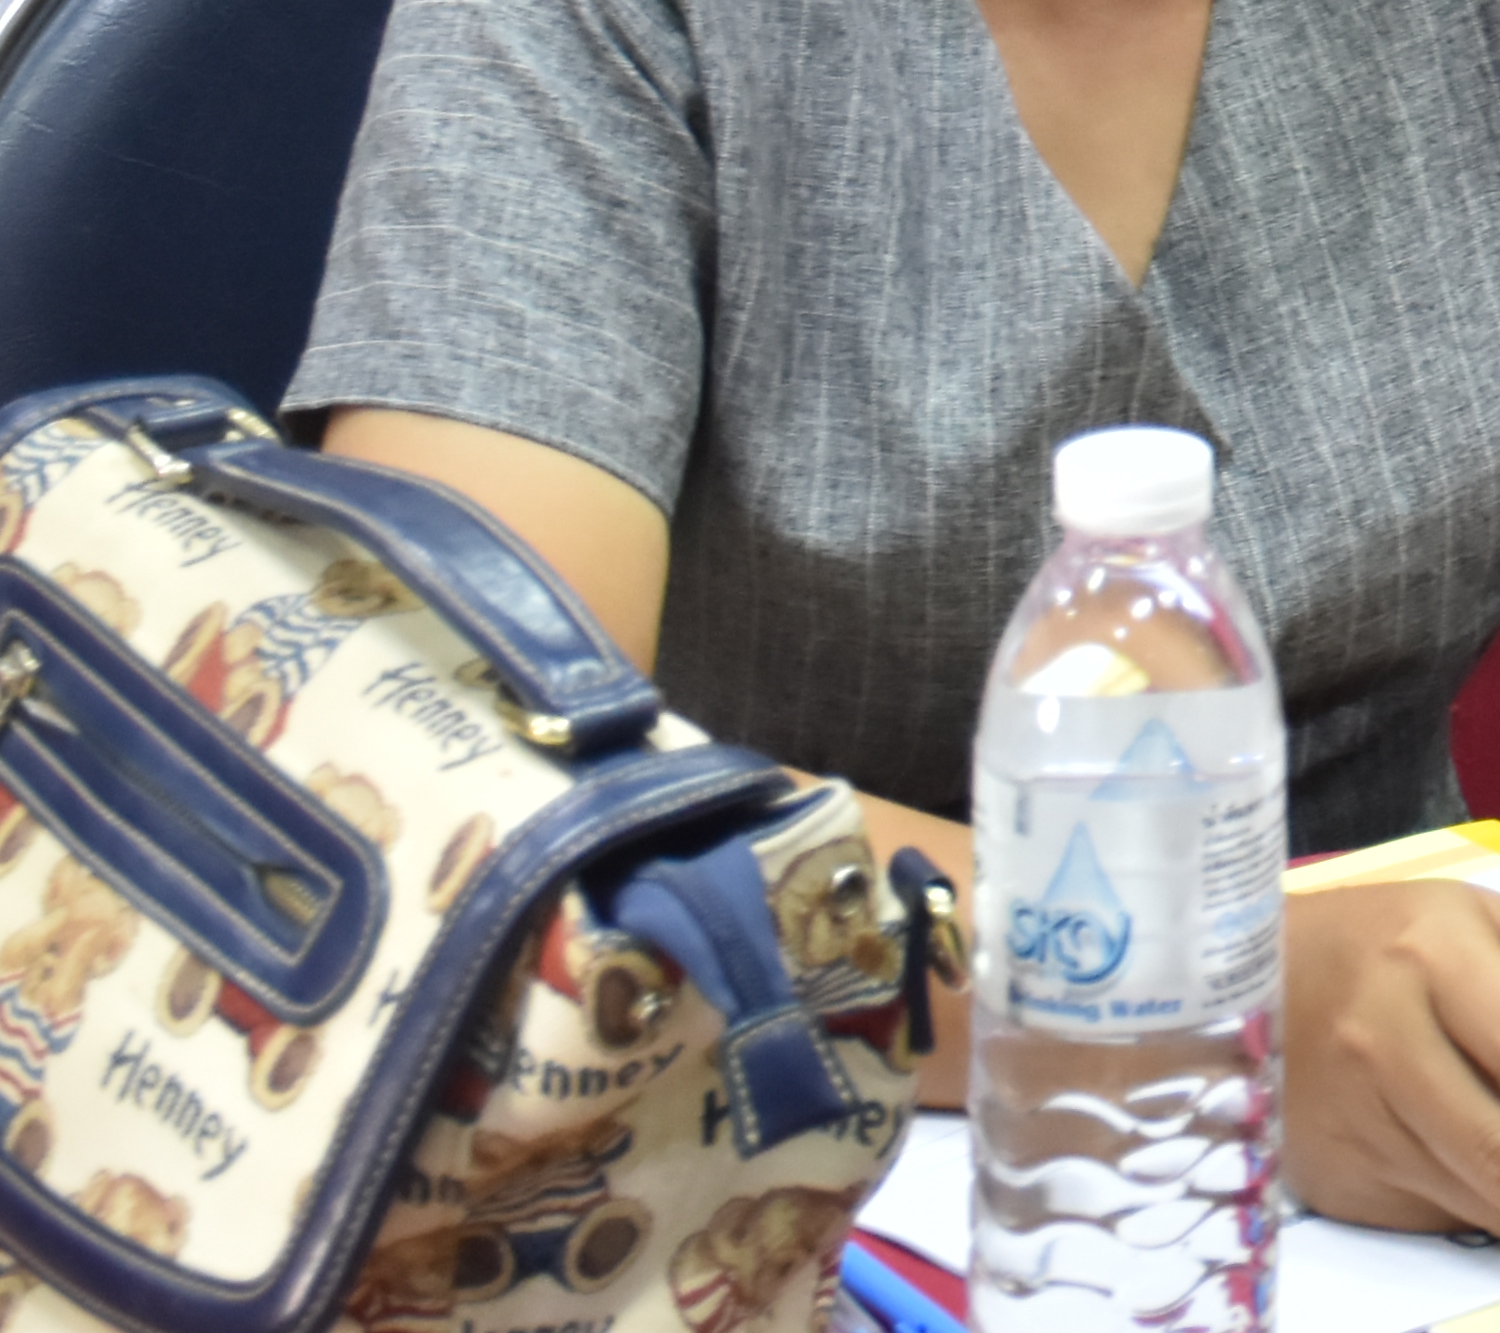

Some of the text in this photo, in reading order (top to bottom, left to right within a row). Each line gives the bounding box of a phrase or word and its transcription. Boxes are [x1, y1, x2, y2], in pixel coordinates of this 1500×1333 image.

[105, 475, 242, 567] Henney
[362, 660, 508, 772] Henney
[100, 1030, 250, 1182] Henney
